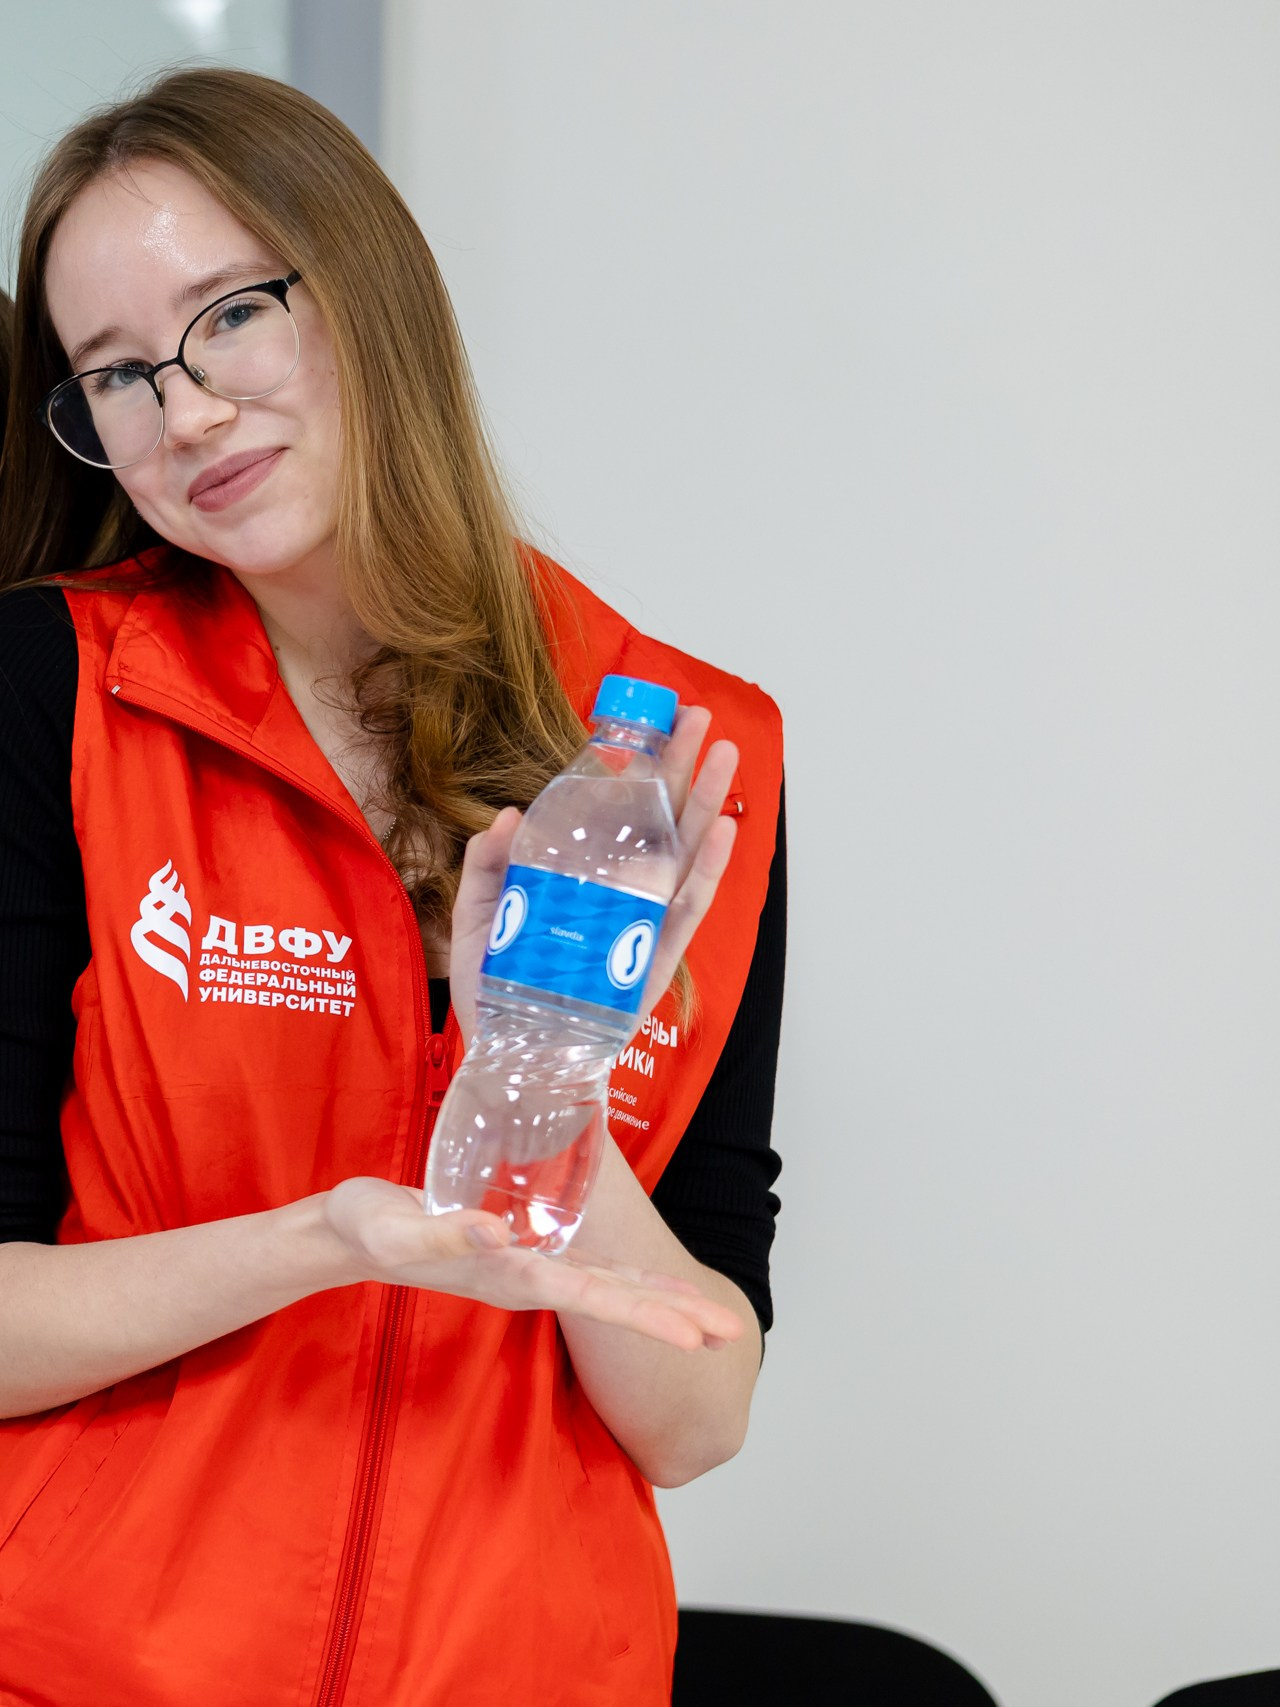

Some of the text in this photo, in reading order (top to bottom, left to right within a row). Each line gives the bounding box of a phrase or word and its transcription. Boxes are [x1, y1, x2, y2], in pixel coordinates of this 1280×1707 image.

[201, 914, 353, 963] ДВФУ
[199, 953, 356, 983] ДАЛЬНЕВОСТОЧНЫЙ
[199, 968, 357, 998] ФЕДЕРАЛЬНЫЙ
[198, 986, 355, 1017] УНИВЕРСИТЕТ
